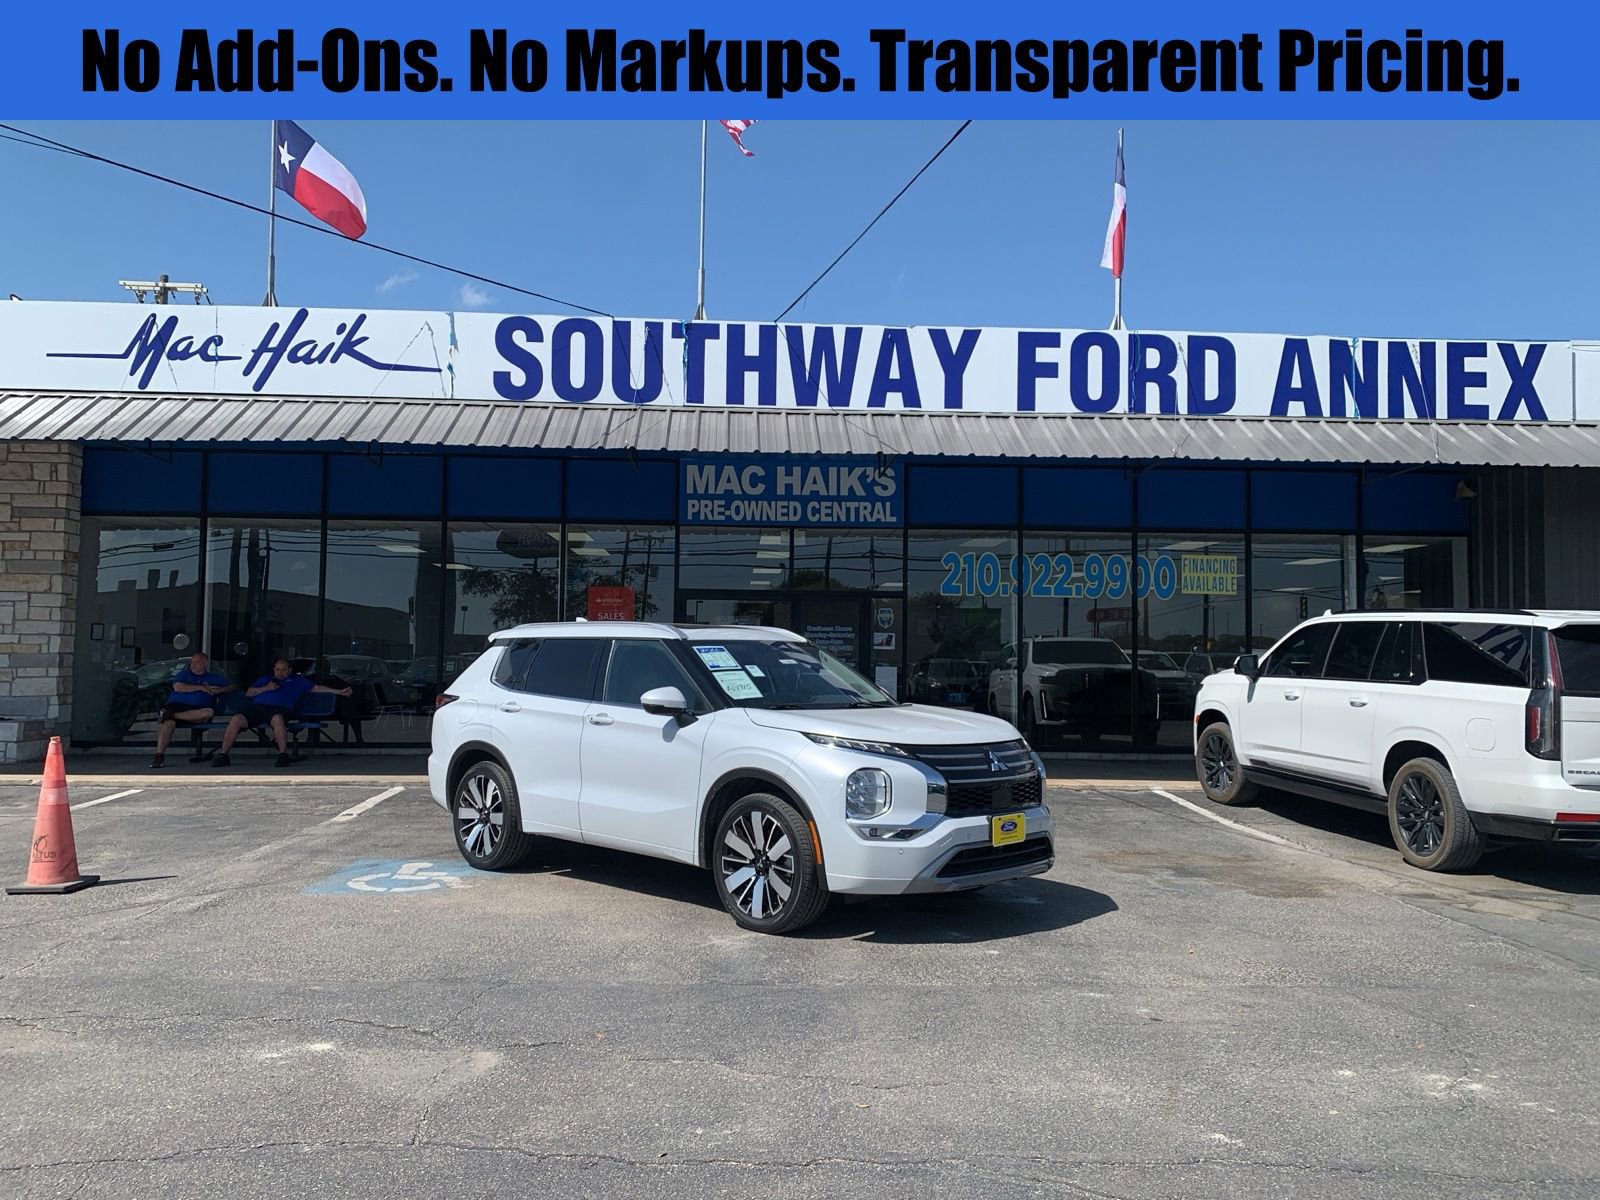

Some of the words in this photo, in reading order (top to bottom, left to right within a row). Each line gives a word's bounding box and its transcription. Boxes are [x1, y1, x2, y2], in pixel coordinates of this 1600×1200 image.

[47, 312, 242, 390] Mac
[242, 307, 443, 392] Haik
[493, 315, 981, 412] SOUTHWAY
[1017, 330, 1236, 415] FORD
[1270, 337, 1547, 421] ANNEX
[686, 464, 766, 495] MAC
[776, 466, 897, 497] HAIK'S
[687, 499, 801, 521] PRE-OWNED
[807, 501, 897, 522] CENTRAL
[940, 551, 1177, 600] 210.922.9900
[1181, 557, 1236, 575] FINANCING
[1181, 575, 1237, 593] AVAILABLE
[598, 612, 625, 620] SALES
